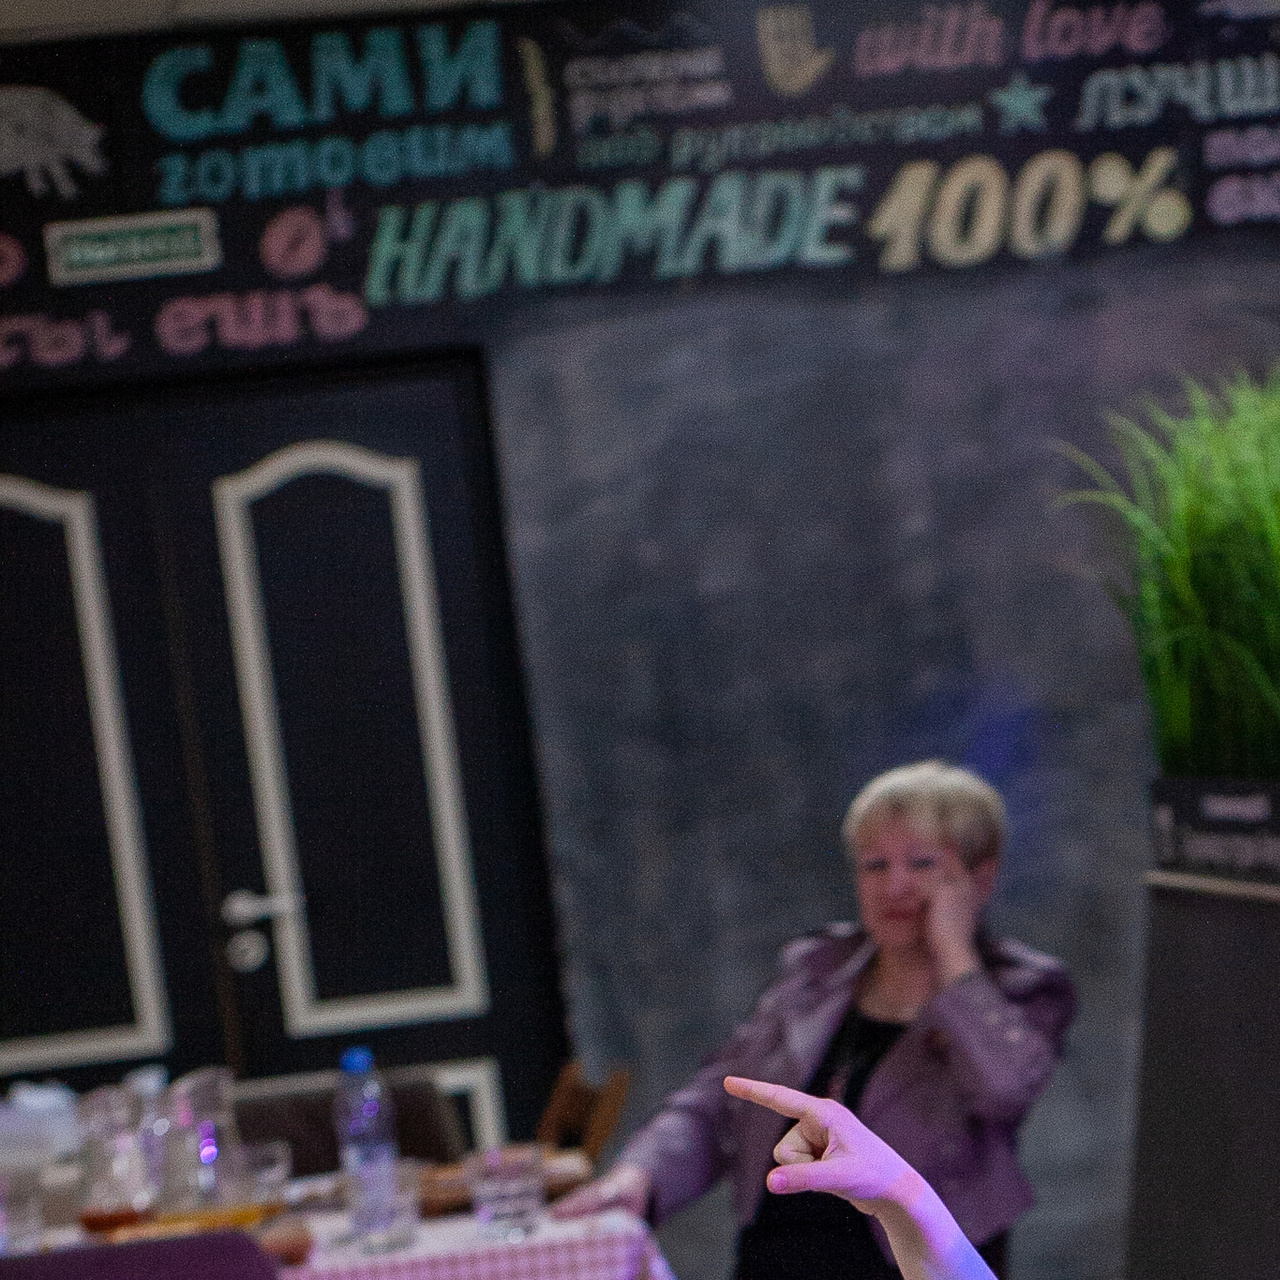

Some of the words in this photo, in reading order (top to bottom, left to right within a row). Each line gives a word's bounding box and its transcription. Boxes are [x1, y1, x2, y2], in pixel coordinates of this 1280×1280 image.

[140, 20, 503, 142] САМИ
[1020, 0, 1169, 63] love
[364, 164, 866, 306] HANDMADE
[870, 147, 1193, 272] 100%
